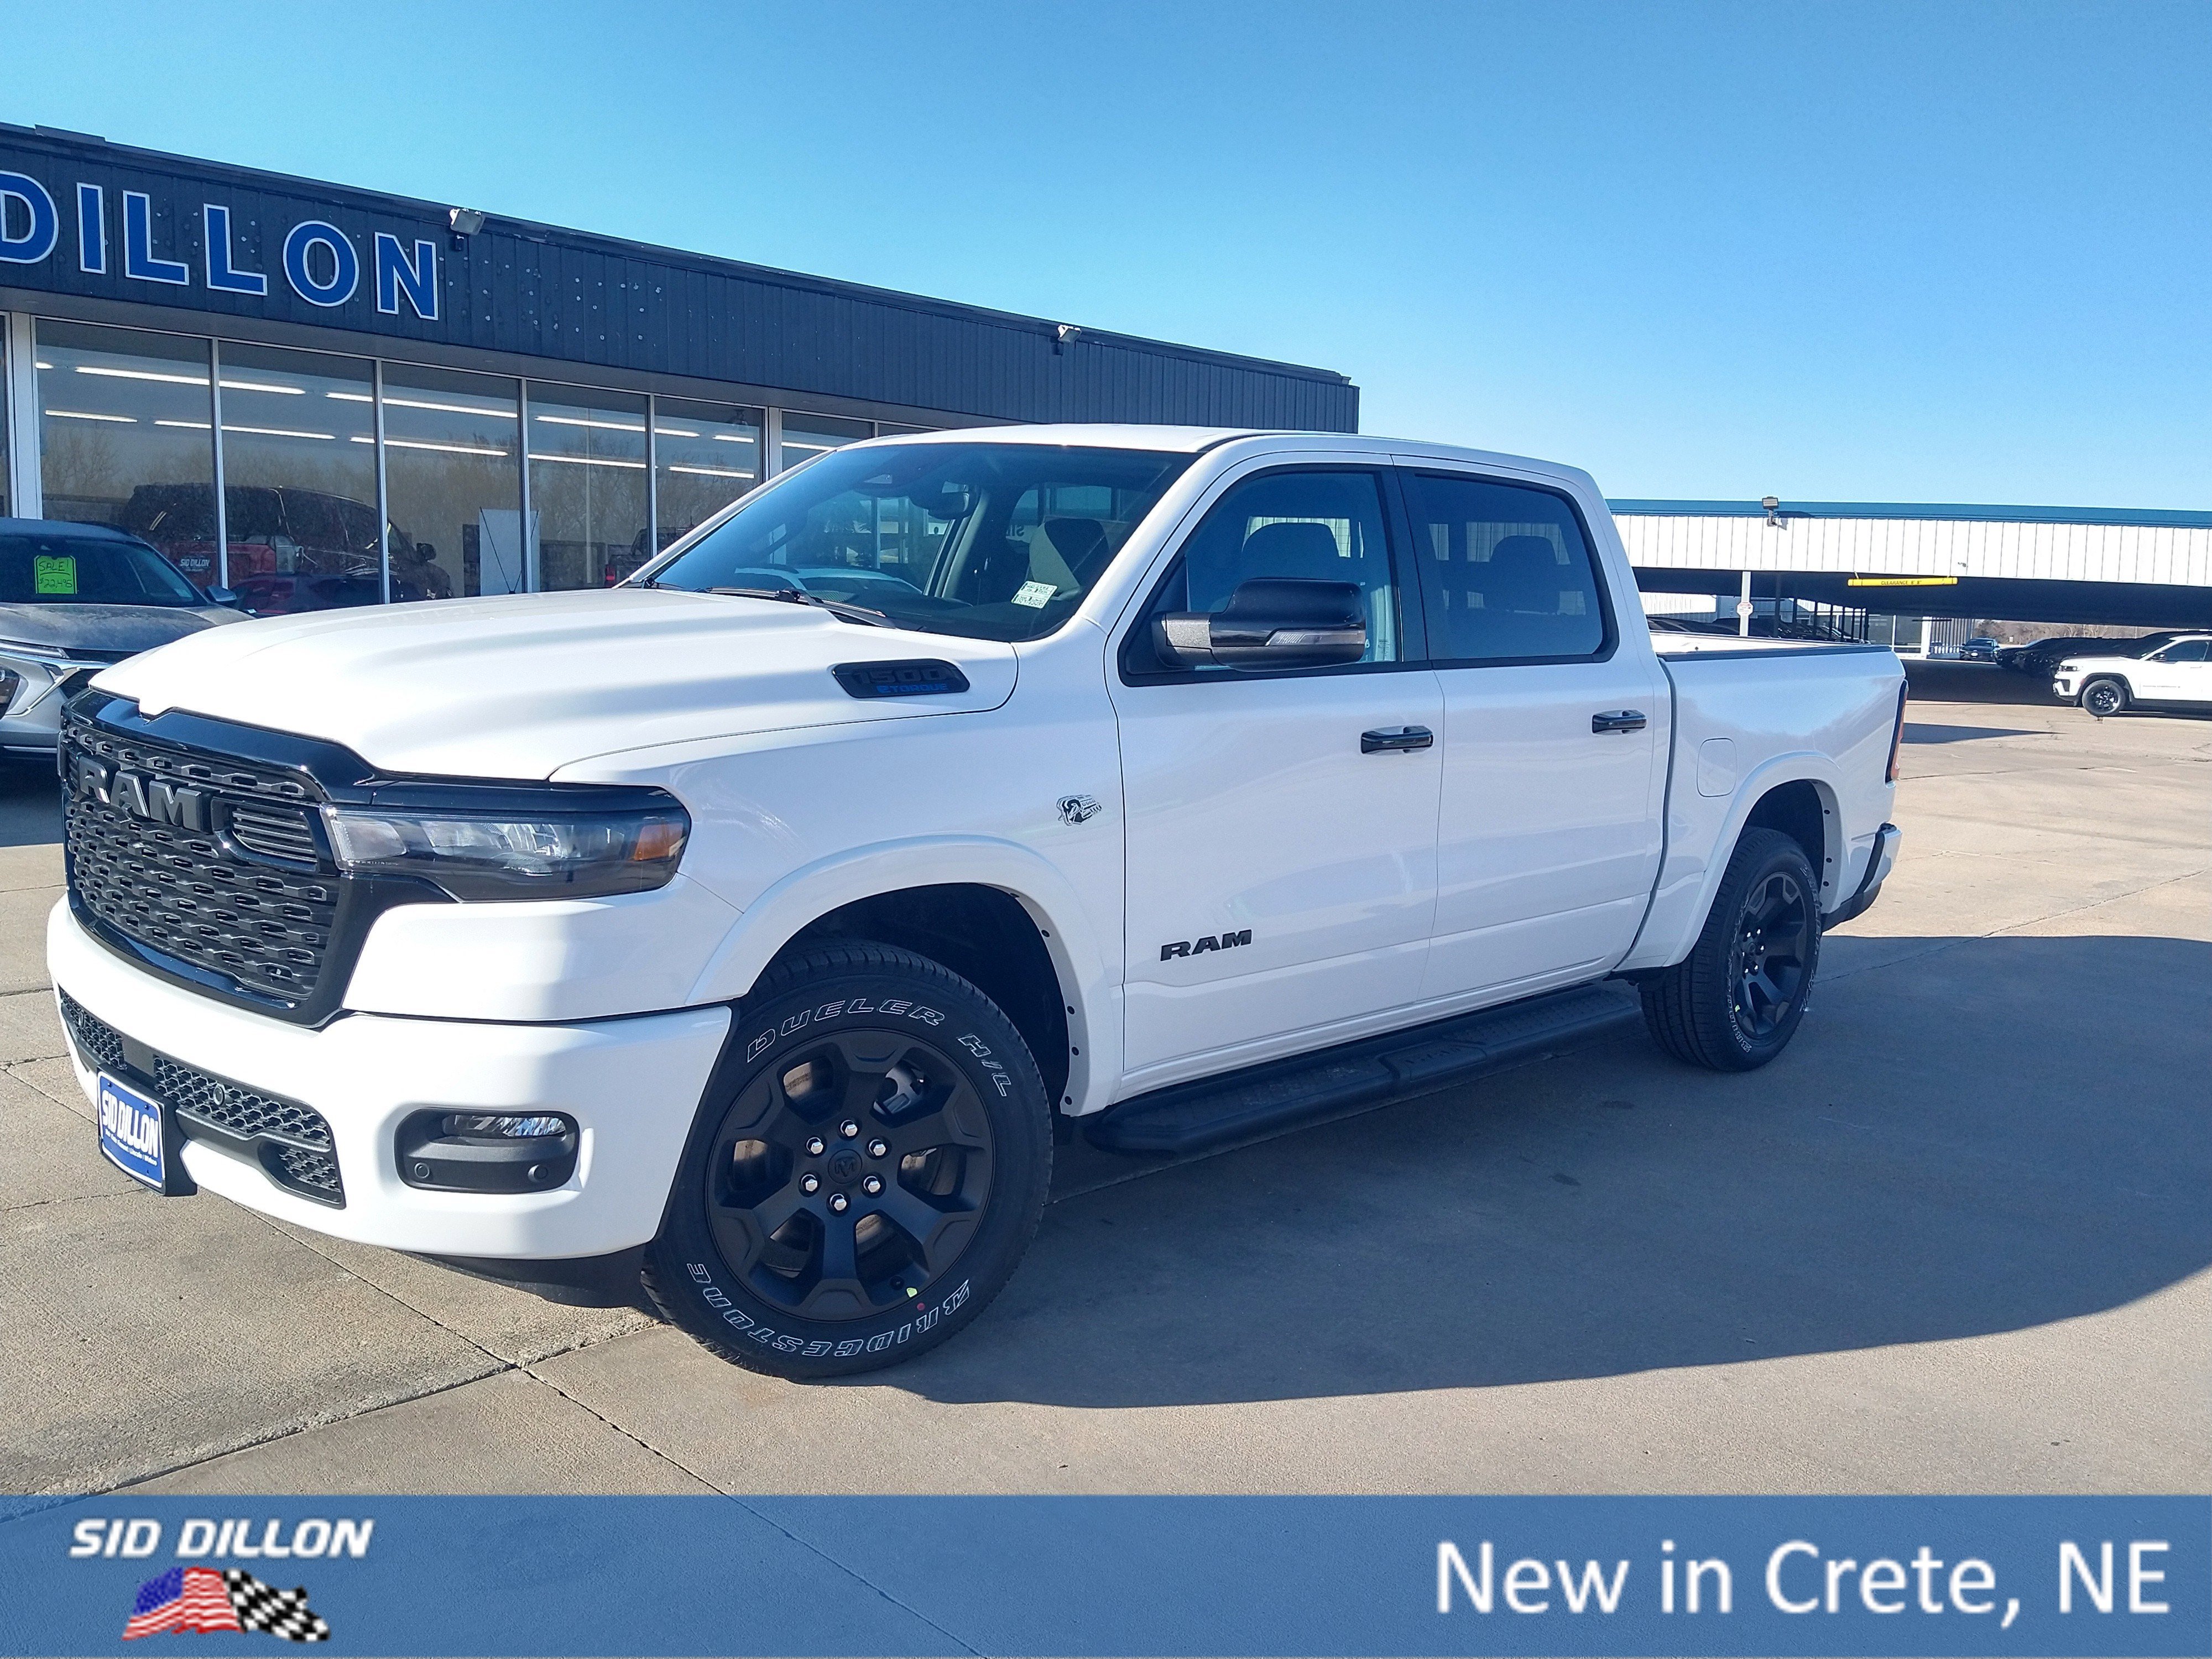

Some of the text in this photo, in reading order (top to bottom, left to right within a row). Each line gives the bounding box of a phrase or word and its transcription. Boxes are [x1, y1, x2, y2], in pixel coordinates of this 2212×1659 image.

[0, 170, 439, 321] DILLON
[852, 667, 949, 684] 1500
[77, 756, 202, 831] RAM
[1160, 929, 1252, 962] RAM
[747, 998, 945, 1063] DUELER
[102, 1090, 118, 1134] SID
[117, 1100, 159, 1159] DILLON
[686, 1262, 970, 1357] BRIDGESTONE
